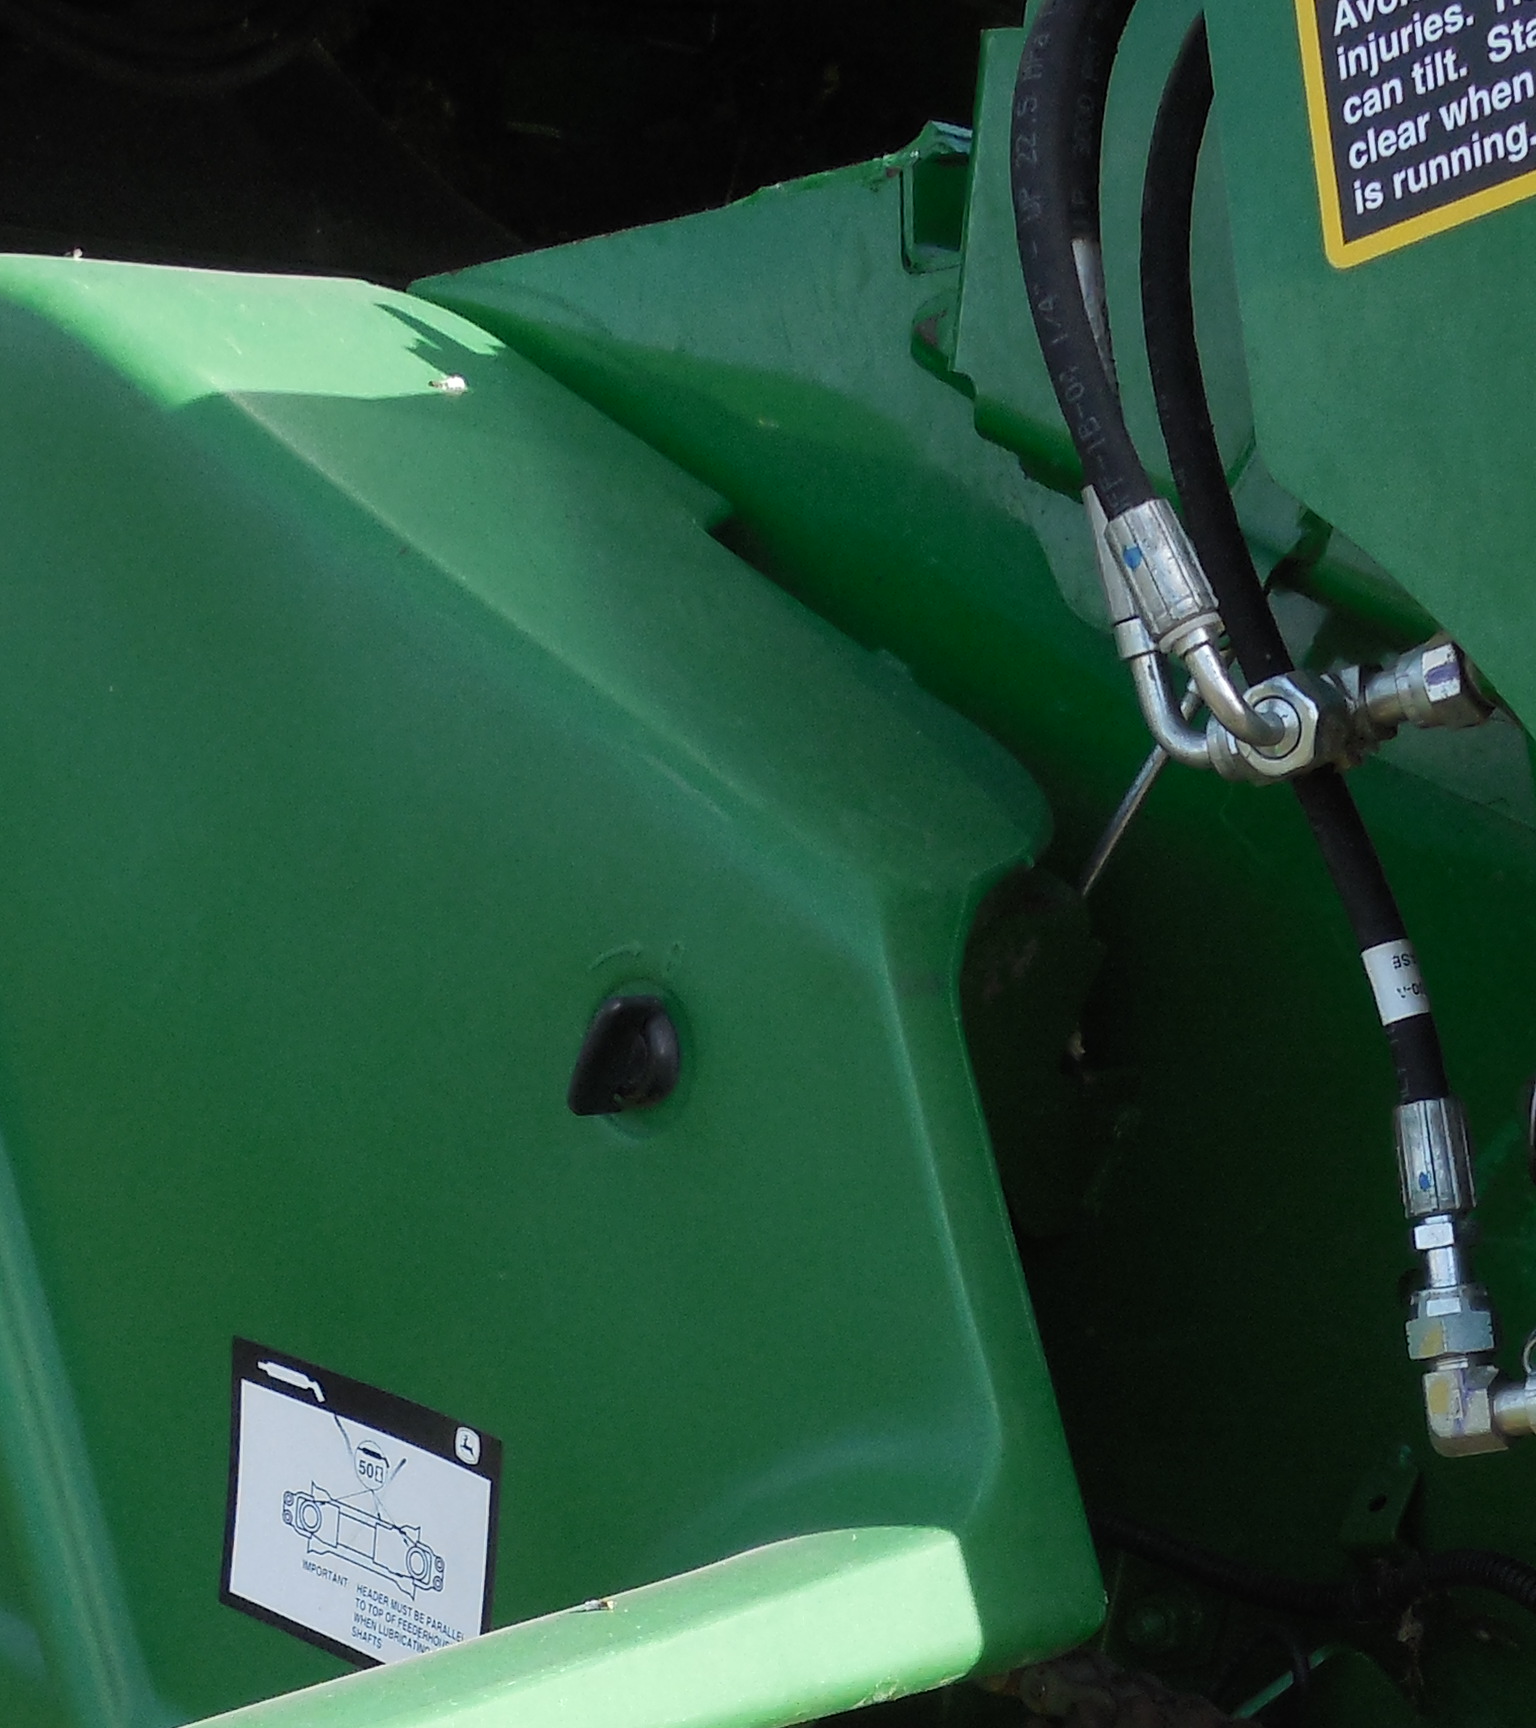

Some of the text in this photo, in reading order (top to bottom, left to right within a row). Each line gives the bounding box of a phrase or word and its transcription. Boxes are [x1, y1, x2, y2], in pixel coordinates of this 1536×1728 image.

[1333, 0, 1419, 36] Avo
[1337, 4, 1474, 80] injuries.
[1343, 78, 1404, 125] can
[1411, 48, 1469, 95] tilt.
[1348, 112, 1431, 170] clear
[1439, 71, 1535, 132] when
[1353, 180, 1384, 215] is
[358, 1459, 374, 1478] 50
[302, 1559, 349, 1588] IMPORTANT
[357, 1584, 389, 1607] HEADER
[391, 1599, 413, 1617] MUST
[413, 1610, 425, 1624] BE
[353, 1612, 377, 1631] WHEN
[355, 1597, 366, 1611] TO
[368, 1603, 383, 1617] TOP
[385, 1612, 396, 1623] OF
[351, 1626, 383, 1649] SHAFTS
